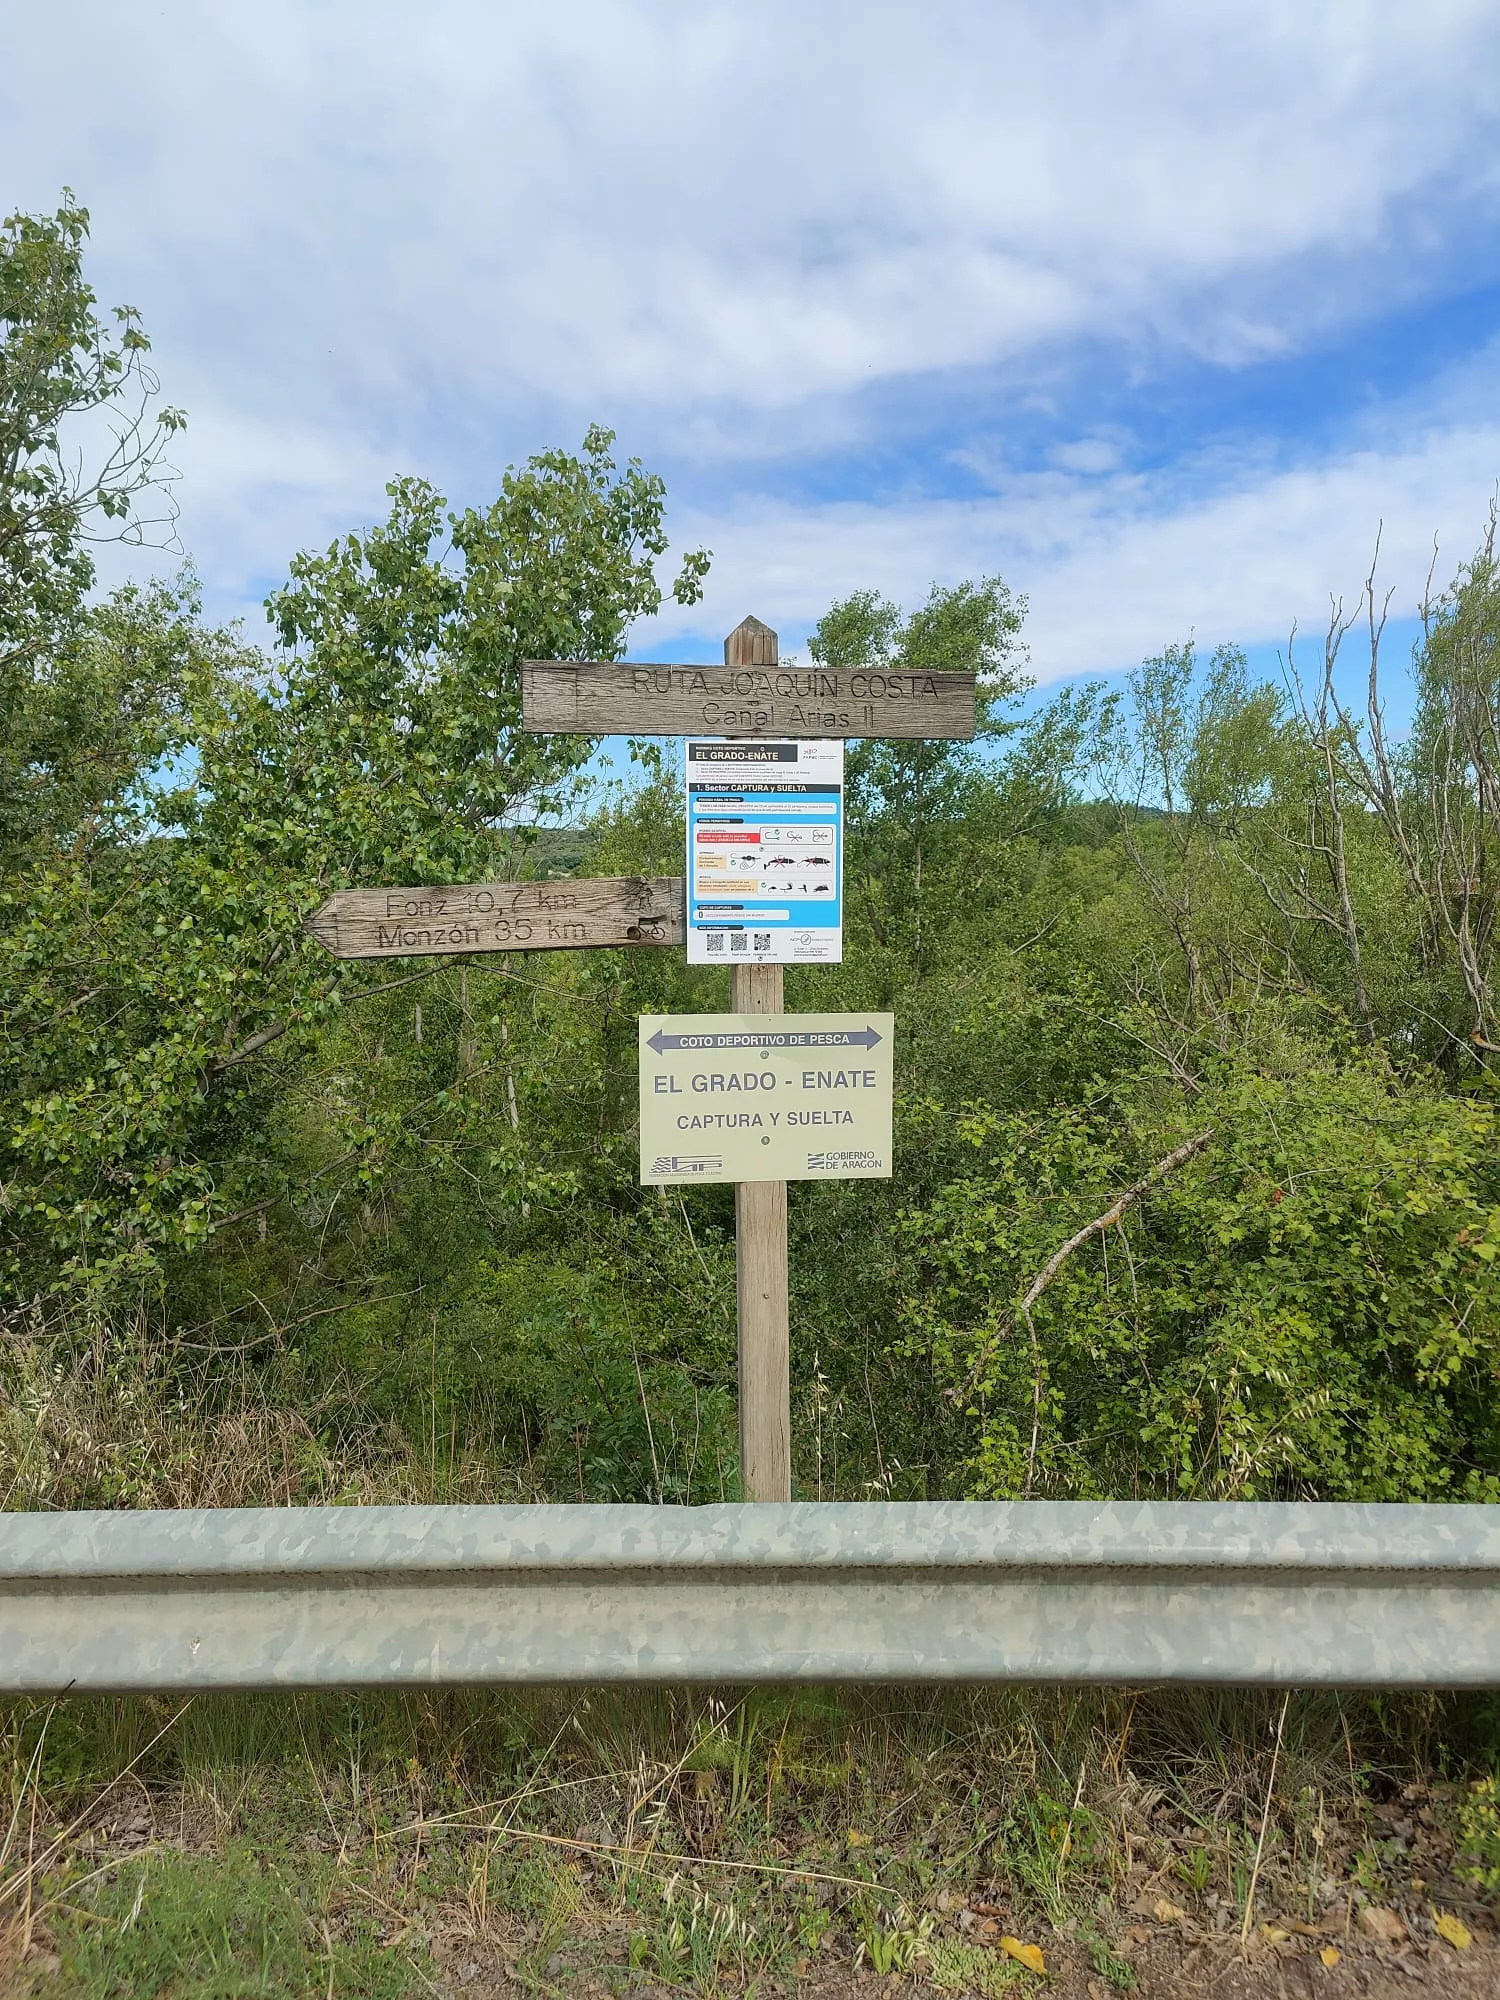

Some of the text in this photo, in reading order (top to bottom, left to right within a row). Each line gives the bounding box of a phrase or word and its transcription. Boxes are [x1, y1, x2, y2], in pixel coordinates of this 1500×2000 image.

[632, 669, 709, 694] RUTA
[850, 674, 939, 699] COSTA
[702, 702, 775, 726] Canal
[787, 704, 850, 728] Arias
[695, 751, 779, 761] EL GRADO-ENATE
[696, 784, 703, 792] 1.
[704, 784, 730, 792] Sector
[730, 784, 769, 792] CAPTURA
[776, 784, 807, 792] SUELTA
[386, 889, 577, 918] Fonz 10,7 km
[378, 918, 586, 948] Monzón 35 km
[679, 1033, 850, 1048] COTO DEPORTIVO DE PESCA
[654, 1075, 683, 1094] EL
[691, 1072, 777, 1093] GRADO
[802, 1070, 877, 1089] ENATE
[676, 1110, 854, 1130] CAPTURA Y SUELTA
[825, 1161, 839, 1170] DE
[826, 1151, 875, 1161] GOBIERNO
